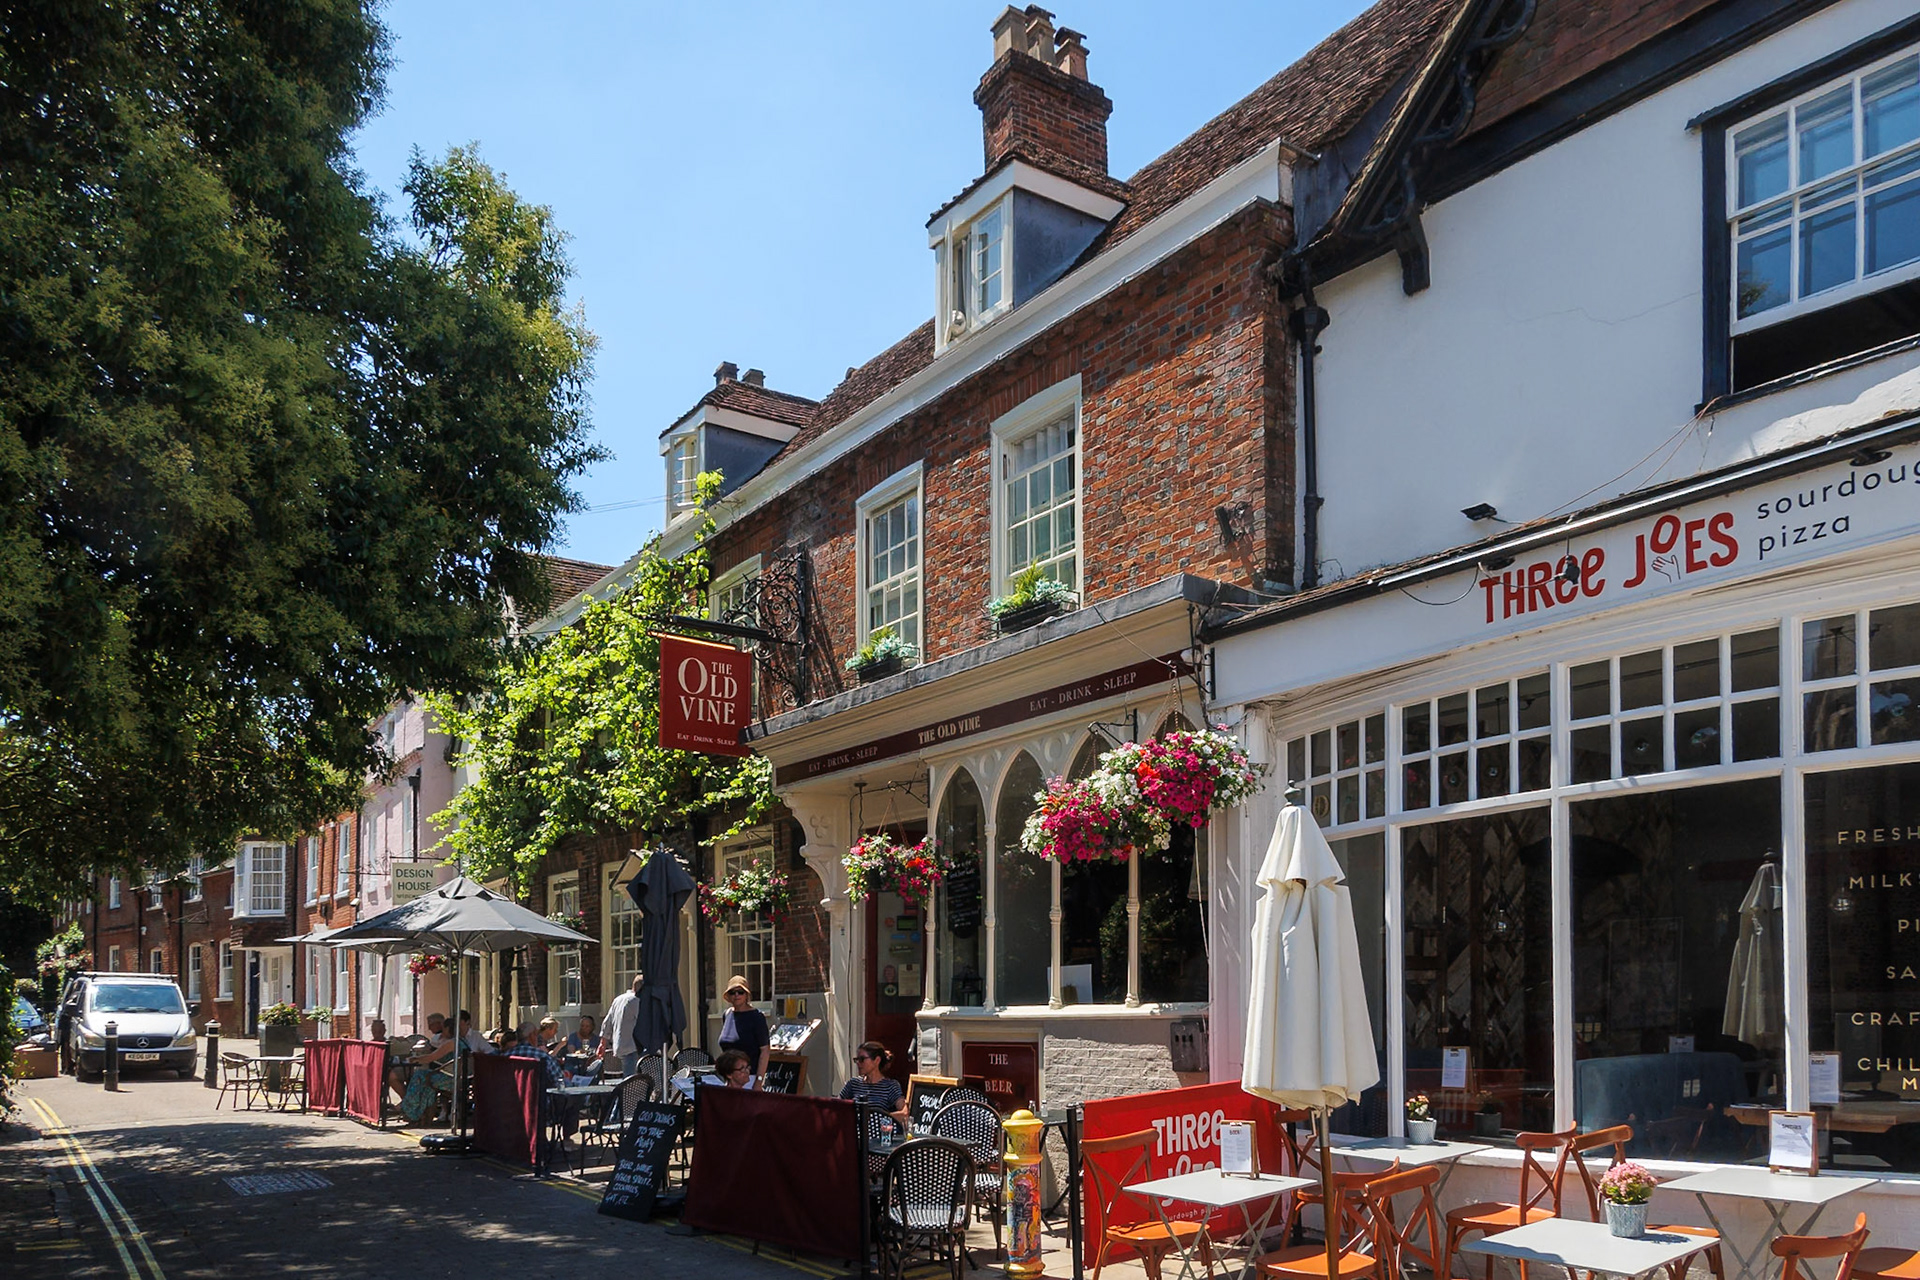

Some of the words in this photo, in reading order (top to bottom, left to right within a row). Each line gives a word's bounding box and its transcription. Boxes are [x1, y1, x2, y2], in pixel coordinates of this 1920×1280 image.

[1759, 516, 1850, 560] pizza
[1623, 512, 1739, 589] JOES
[711, 662, 733, 675] THE
[678, 657, 738, 699] OLD
[1029, 697, 1048, 712] EAT
[1058, 685, 1093, 704] DRINK
[1103, 671, 1138, 691] SLEEP
[679, 695, 736, 725] VINE
[918, 730, 936, 745] THE
[937, 724, 957, 740] OLD
[958, 715, 982, 734] VINE
[808, 762, 822, 773] EAT
[826, 753, 850, 768] DRINK
[856, 746, 879, 761] SLEEP
[1837, 826, 1920, 845] FRESH
[395, 868, 434, 878] DESIGN
[1849, 872, 1920, 889] MILK
[397, 881, 432, 891] HOUSE
[1886, 966, 1916, 979] SA
[1851, 1012, 1920, 1026] CRAF
[988, 1053, 1009, 1066] THE
[1857, 1057, 1920, 1072] CHIL
[984, 1080, 1014, 1094] BEER
[1902, 1076, 1918, 1090] M
[1168, 1209, 1198, 1221] urdough
